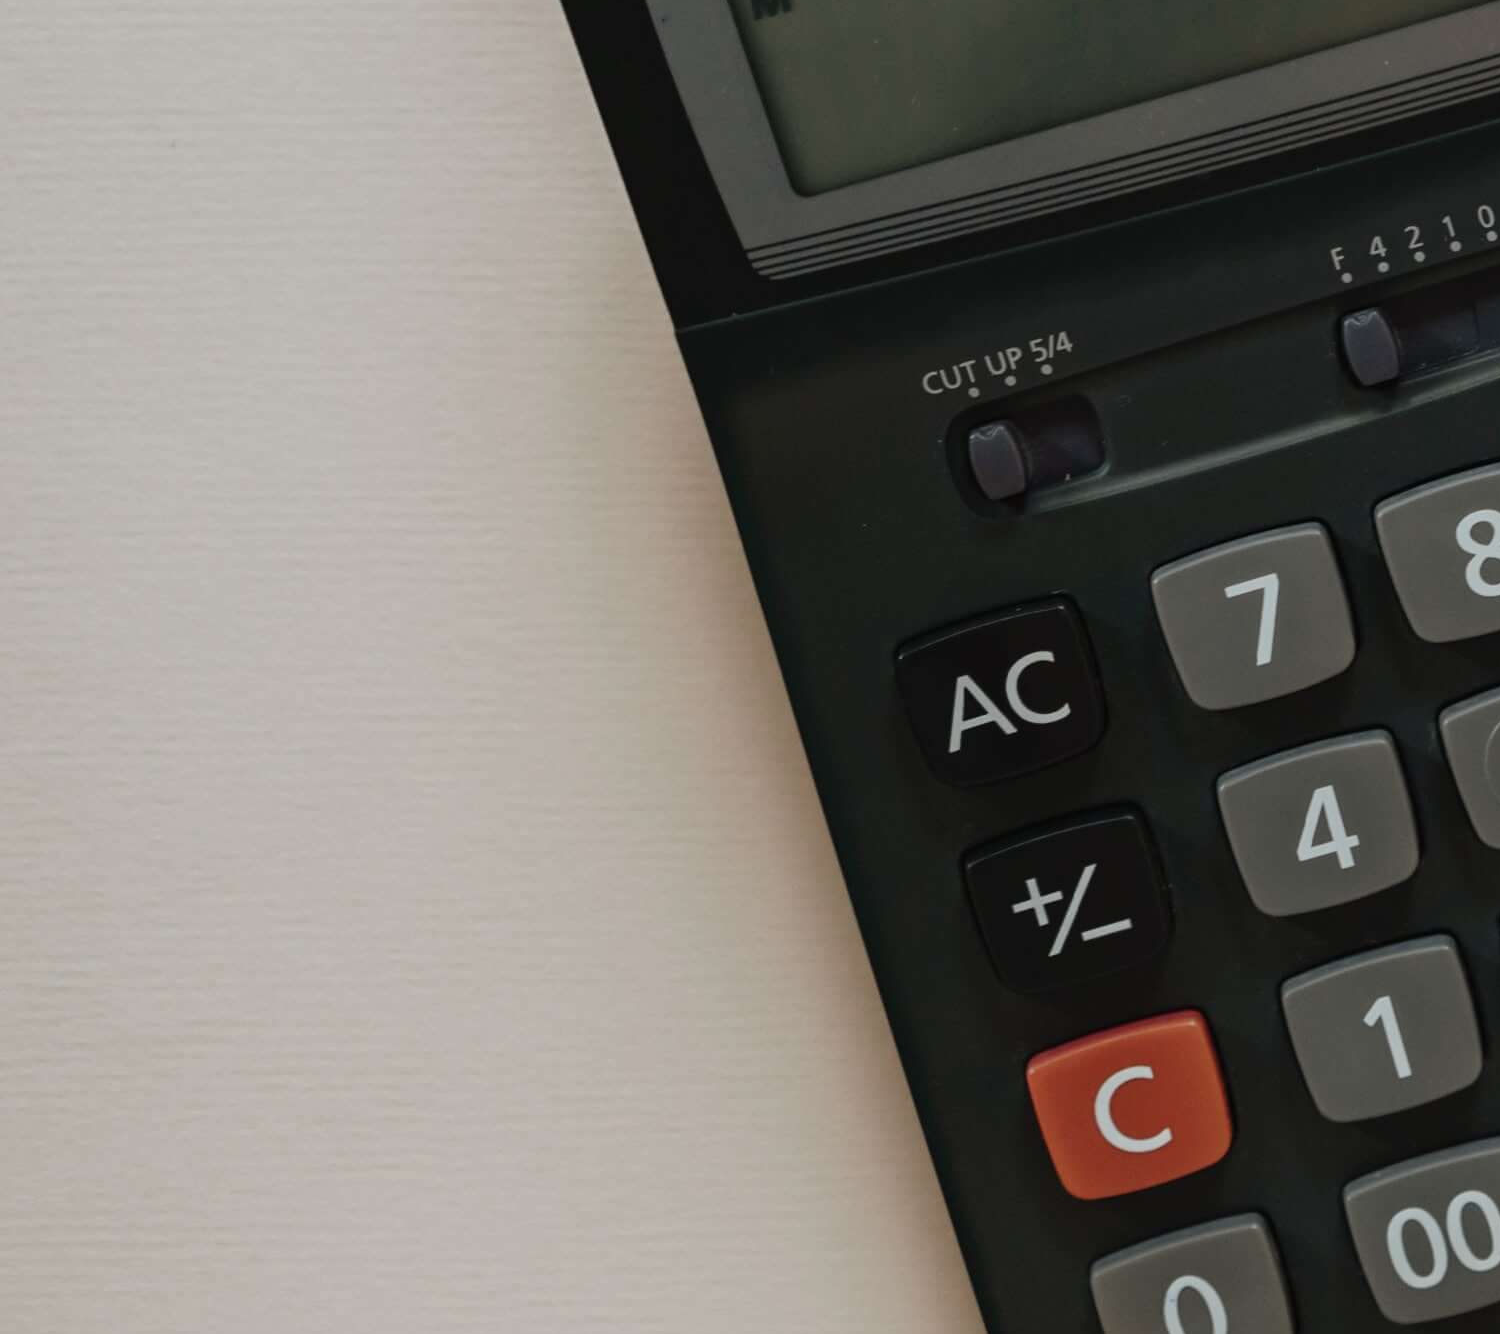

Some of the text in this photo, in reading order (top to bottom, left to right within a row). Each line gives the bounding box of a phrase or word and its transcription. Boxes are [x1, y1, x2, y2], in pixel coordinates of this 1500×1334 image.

[1330, 246, 1345, 271] F
[1369, 235, 1387, 257] 4
[1404, 225, 1425, 250] 2
[1441, 215, 1456, 238] 1
[1477, 204, 1495, 229] 0
[920, 331, 1074, 395] CUT UP 5/4
[1224, 572, 1280, 666] 7
[948, 650, 1071, 754] AC
[1296, 784, 1360, 870] 4
[1363, 995, 1412, 1079] 1
[1094, 1065, 1173, 1153] C
